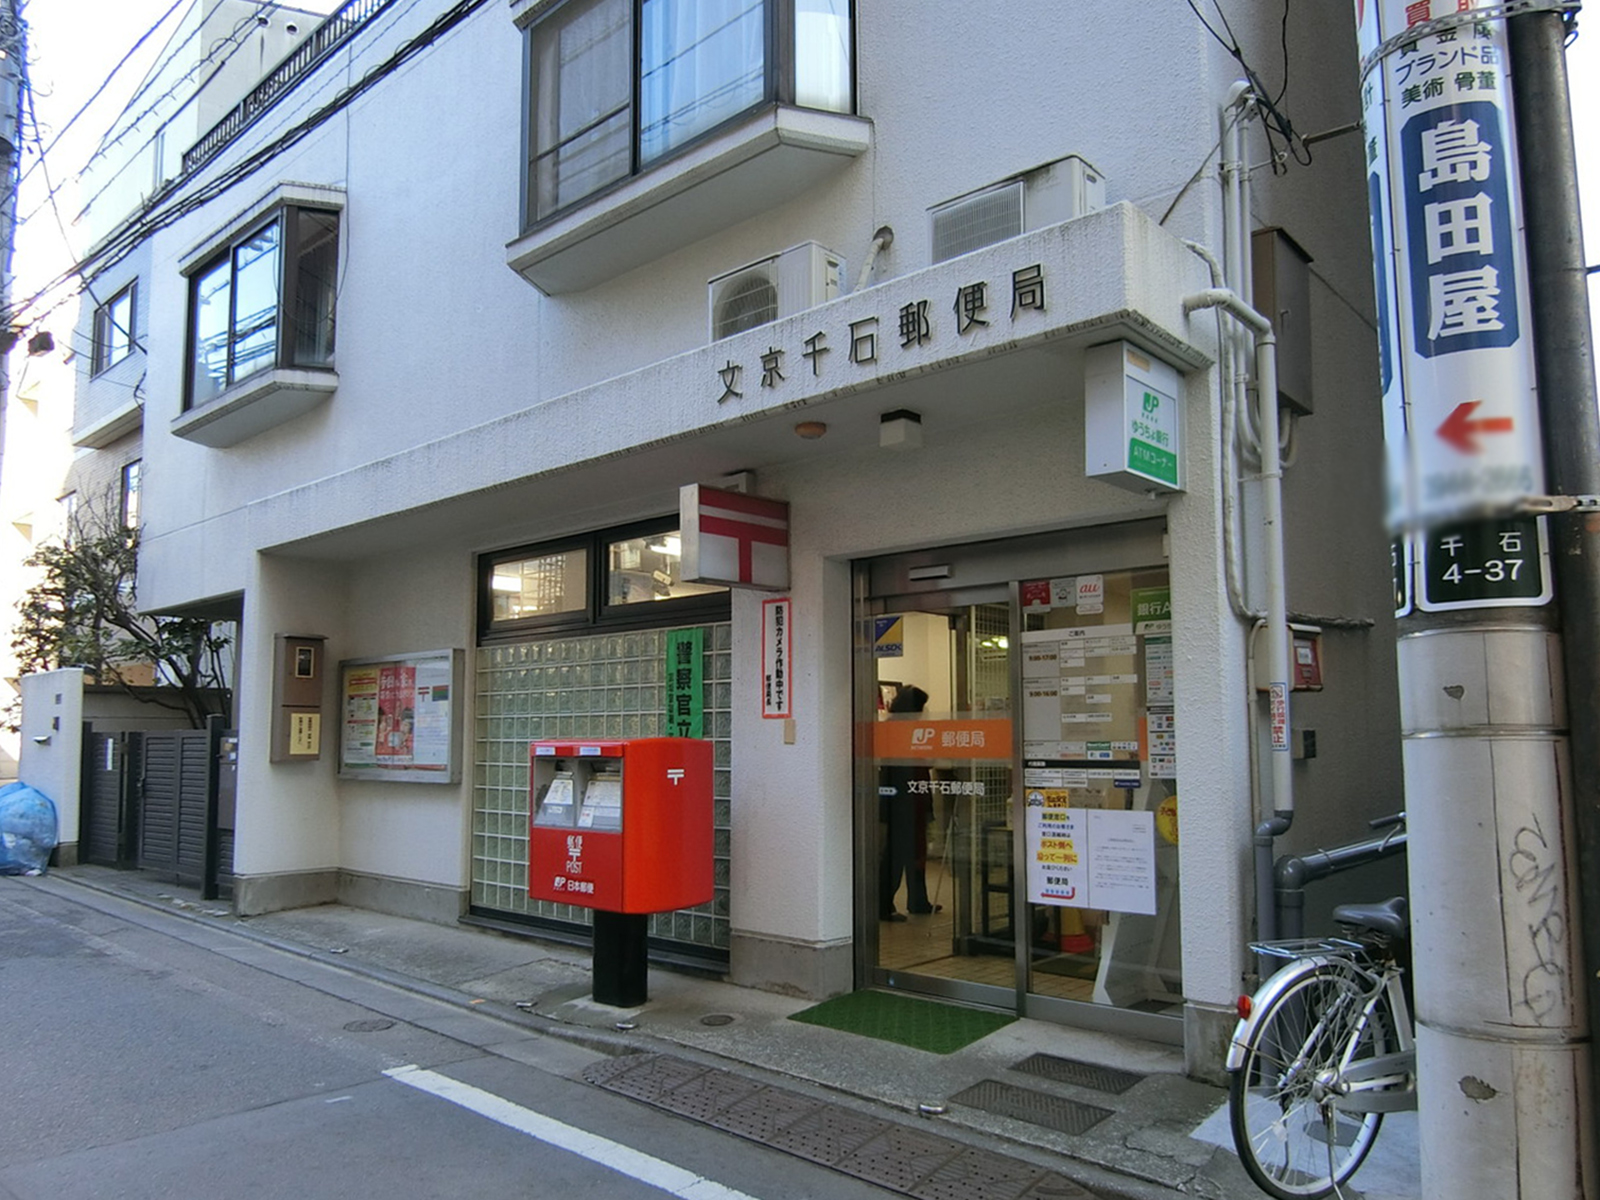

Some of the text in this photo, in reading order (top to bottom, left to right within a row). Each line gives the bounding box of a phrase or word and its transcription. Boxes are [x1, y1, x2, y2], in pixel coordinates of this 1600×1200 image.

[1395, 45, 1499, 86] ブランド品
[1401, 71, 1496, 109] 美術 骨董
[1419, 119, 1505, 341] 島田屋
[716, 264, 1046, 404] 文京千石郵便局
[1132, 420, 1169, 447] ゆうちょ銀行
[1440, 532, 1522, 557] 千石
[1442, 559, 1523, 584] 4-37
[1080, 583, 1100, 594] au
[775, 605, 784, 711] 防犯カメラ作動中です
[875, 643, 903, 653] ALSOK
[676, 641, 693, 738] 警察官立
[941, 731, 985, 748] 郵便局
[907, 780, 985, 797] 文京千石郵便局
[567, 835, 583, 849] 郵便
[566, 861, 582, 874] POST
[567, 880, 595, 894] 日本郵便
[1046, 876, 1069, 886] 郵便局
